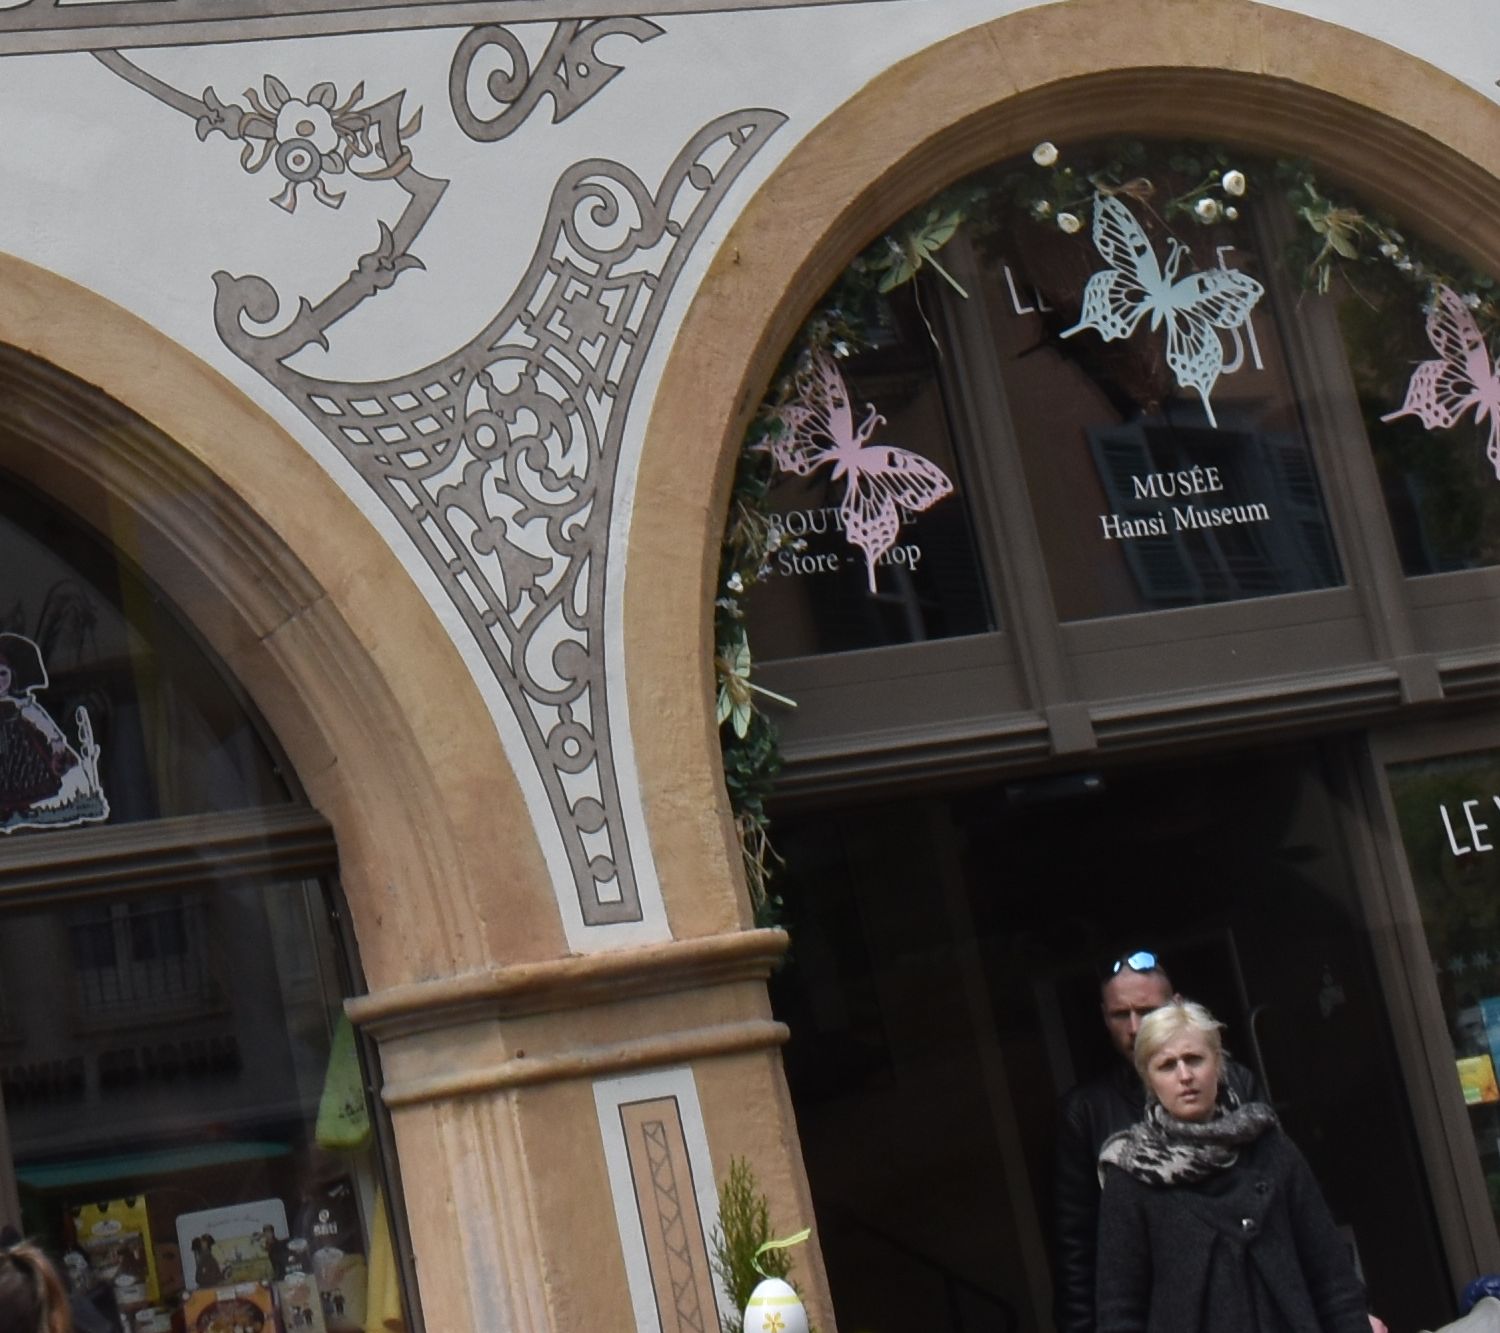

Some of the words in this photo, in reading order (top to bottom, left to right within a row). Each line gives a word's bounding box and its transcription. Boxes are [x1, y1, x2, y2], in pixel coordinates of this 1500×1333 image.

[1131, 464, 1224, 500] MUSÉE
[1099, 510, 1168, 540] Hansi
[1171, 501, 1270, 531] Museum
[777, 551, 840, 577] Store
[863, 543, 922, 572] hop
[1439, 798, 1494, 856] LE
